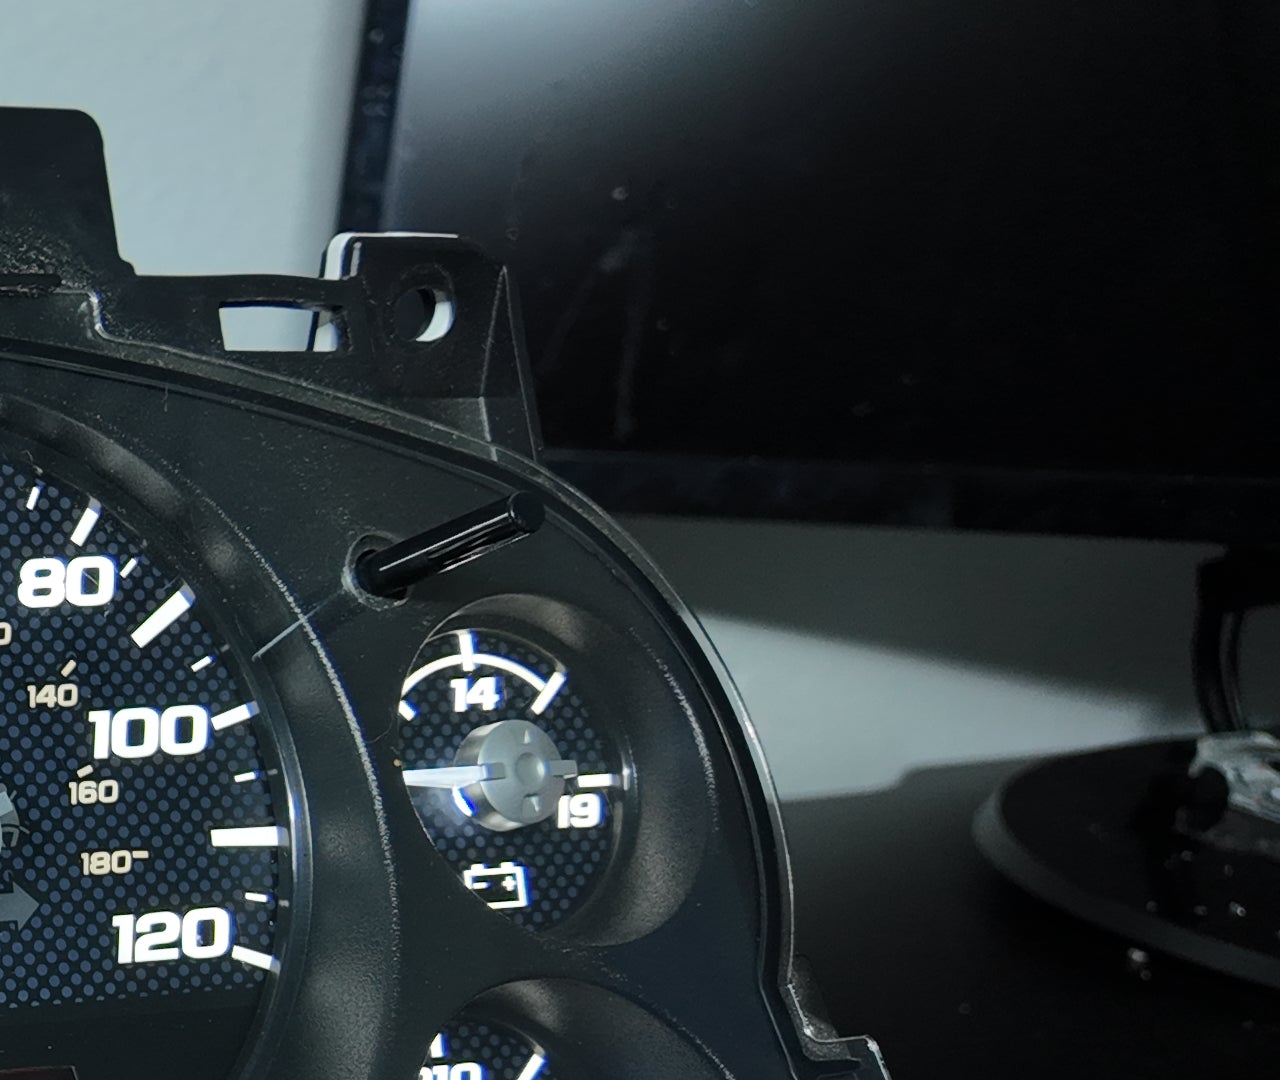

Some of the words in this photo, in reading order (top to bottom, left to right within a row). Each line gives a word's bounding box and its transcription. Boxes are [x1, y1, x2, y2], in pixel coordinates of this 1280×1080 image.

[17, 556, 116, 608] 80
[27, 683, 79, 709] 140
[450, 676, 503, 713] 14
[88, 704, 209, 760] 100
[68, 779, 119, 806] 160
[557, 792, 604, 830] 19
[80, 850, 133, 876] 180
[111, 906, 233, 964] 120
